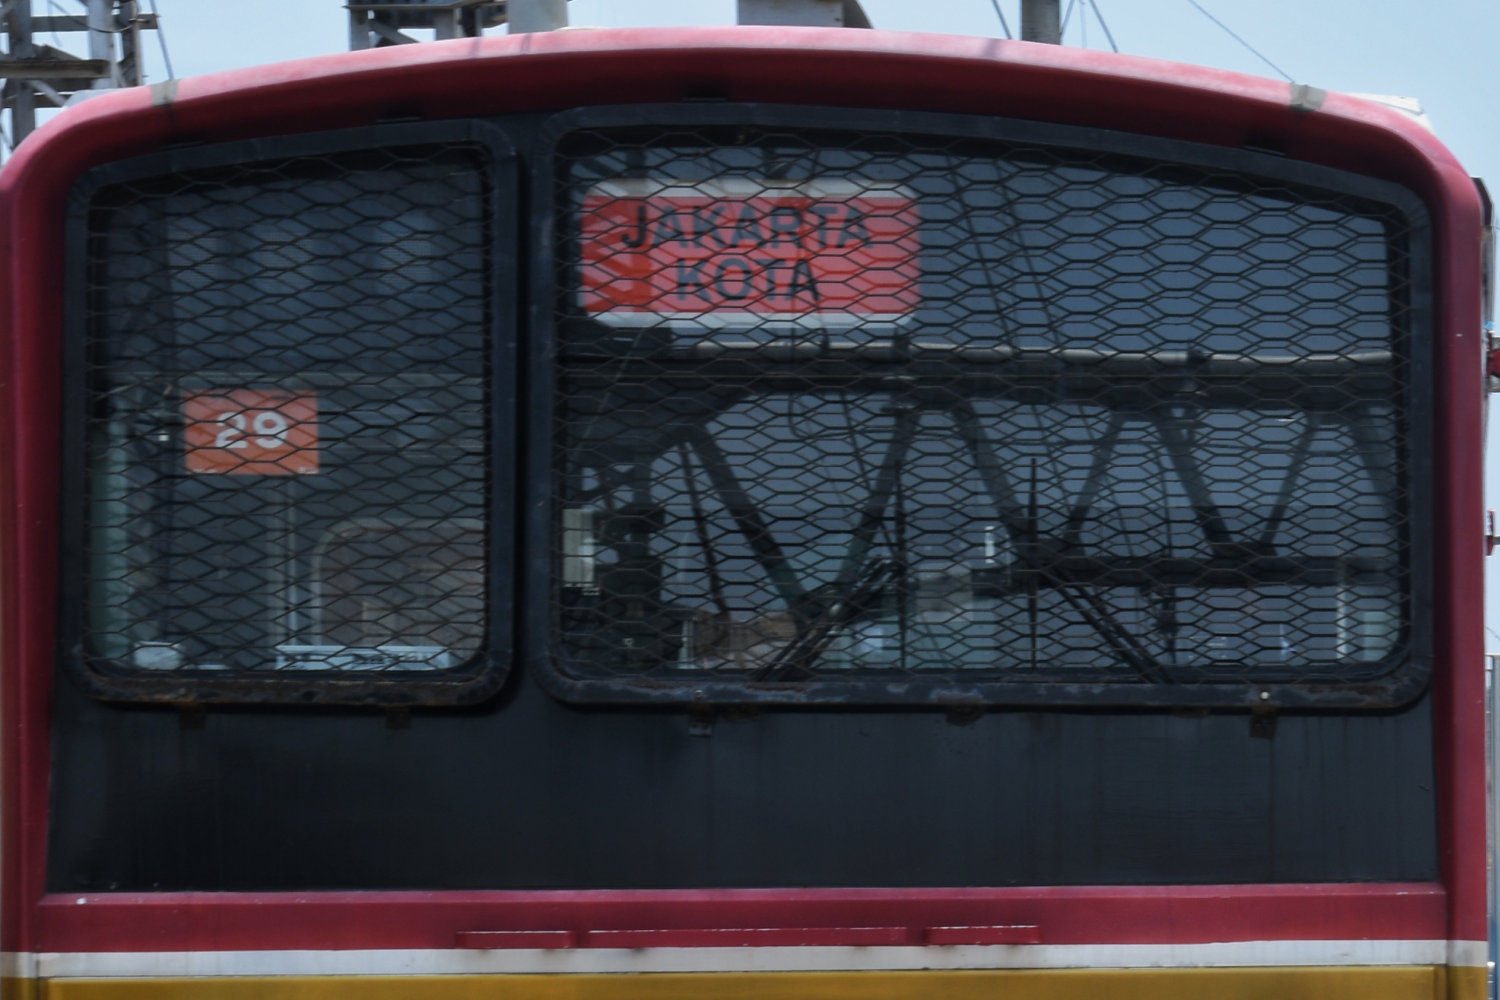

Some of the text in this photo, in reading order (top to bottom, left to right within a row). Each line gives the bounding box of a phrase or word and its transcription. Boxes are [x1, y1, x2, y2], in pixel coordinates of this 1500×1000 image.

[620, 205, 874, 249] JAKARTA
[674, 257, 820, 301] KOTA
[215, 411, 289, 448] 29
